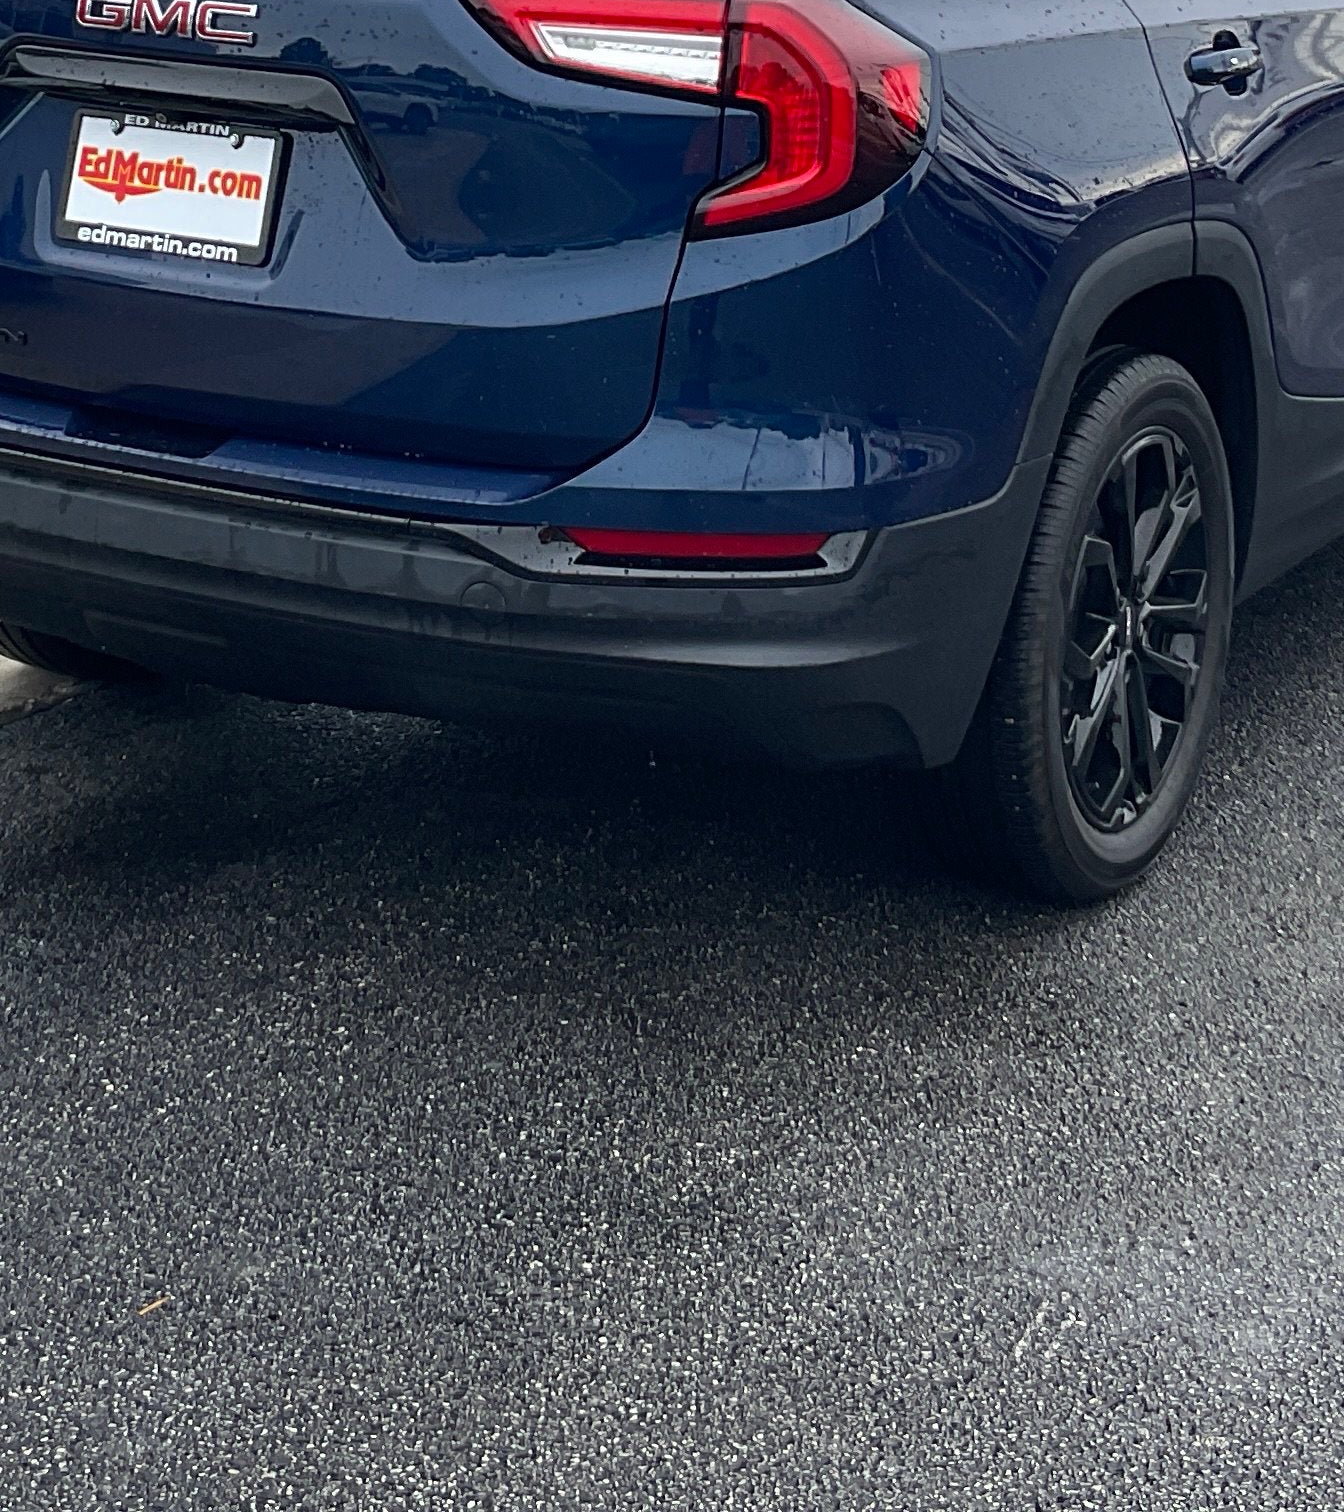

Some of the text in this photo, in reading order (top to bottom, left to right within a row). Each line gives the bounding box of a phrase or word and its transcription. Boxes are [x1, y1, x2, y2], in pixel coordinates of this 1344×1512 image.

[124, 113, 151, 127] ED
[77, 145, 264, 202] EdMartin.com
[76, 224, 239, 263] edmartin.com
